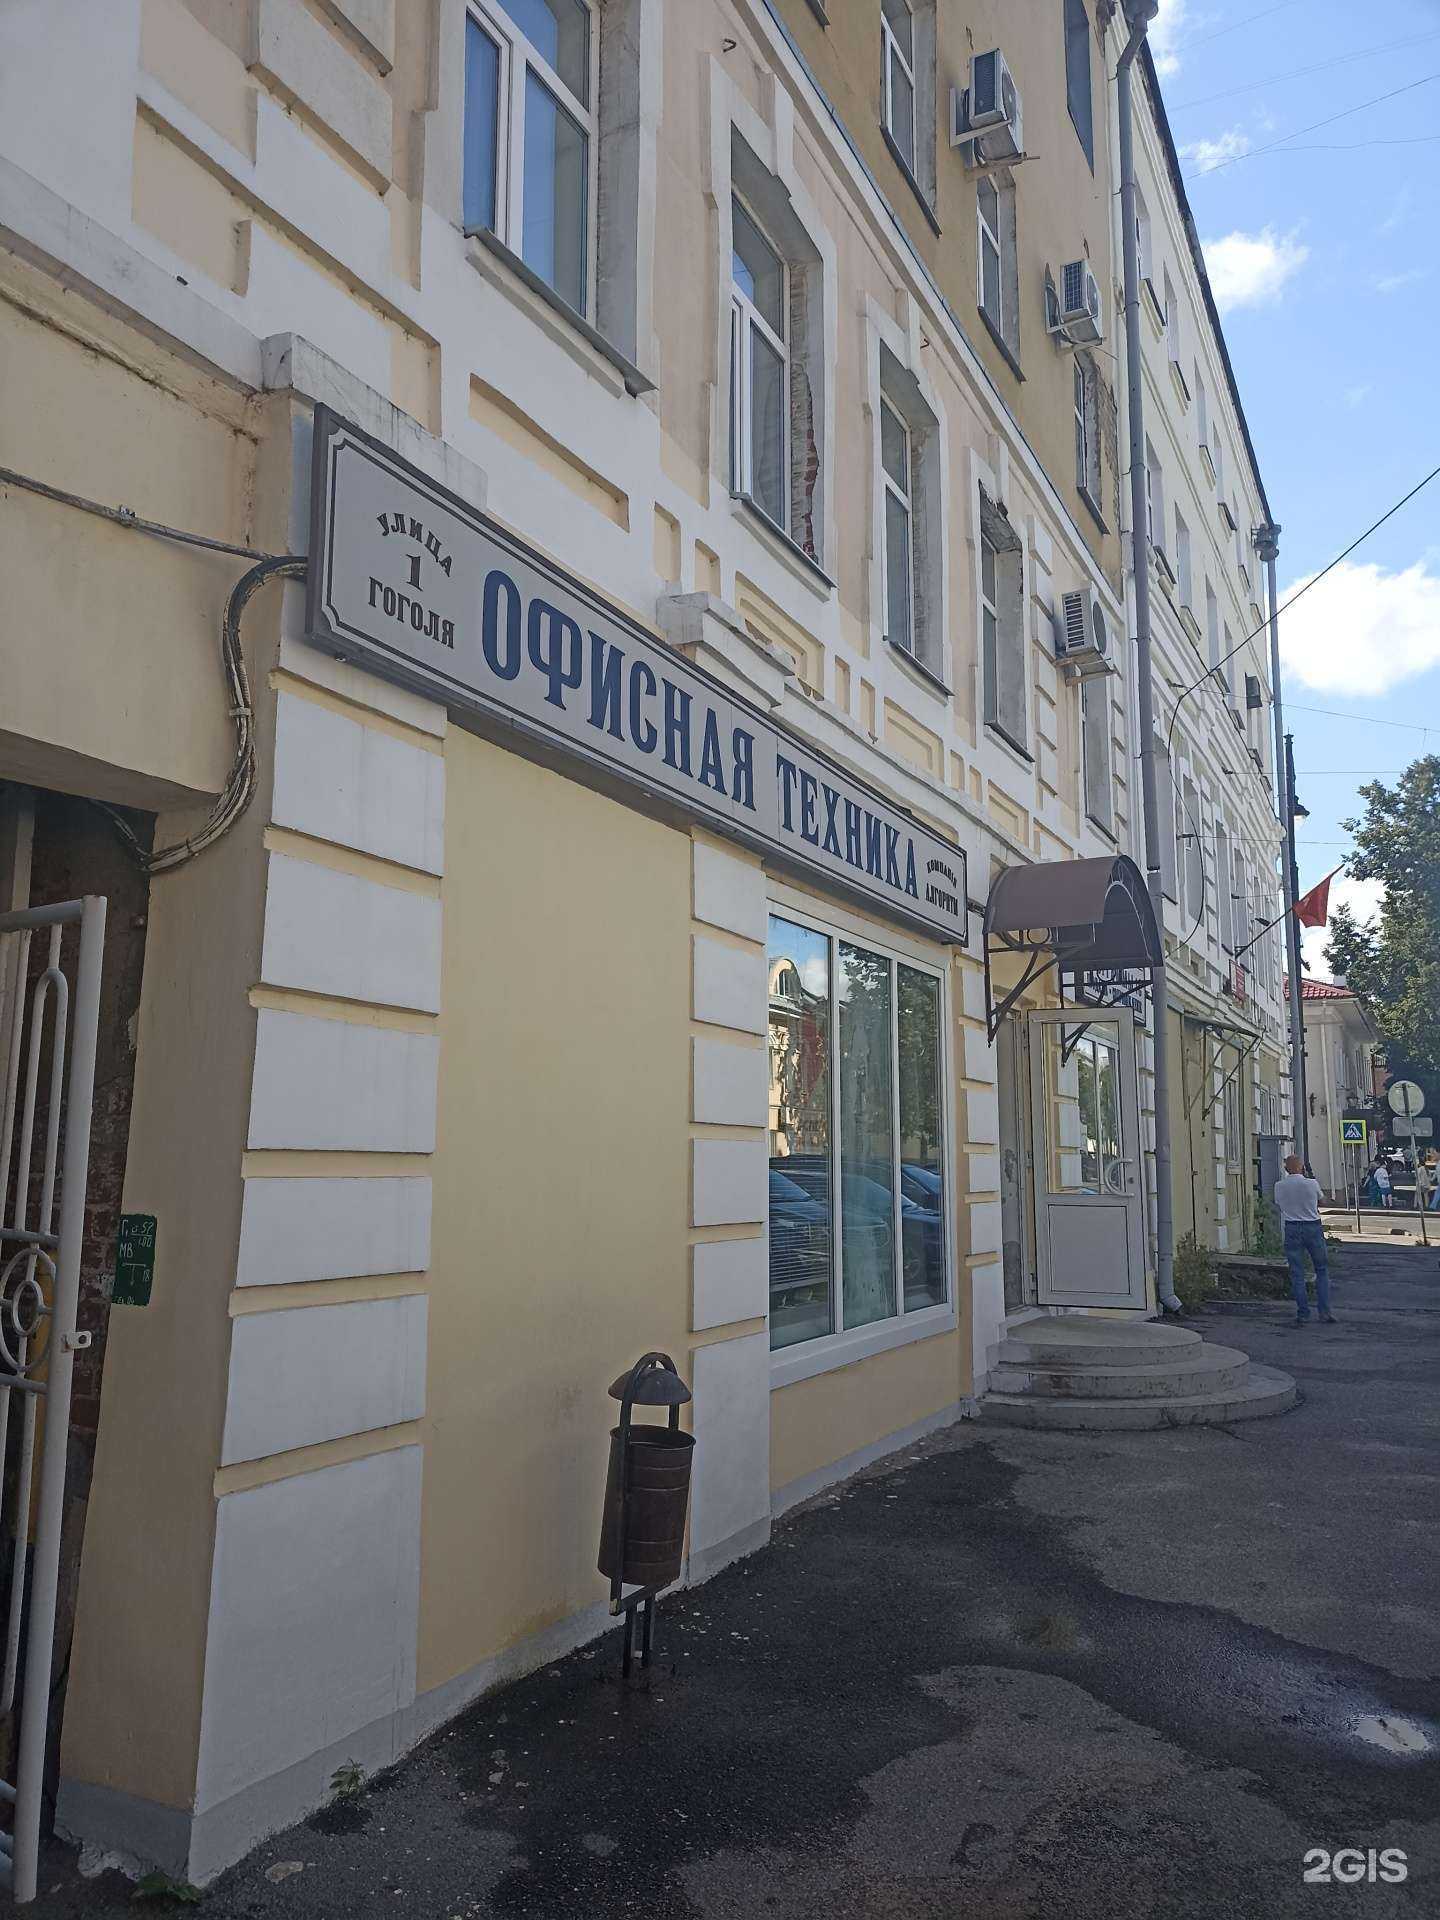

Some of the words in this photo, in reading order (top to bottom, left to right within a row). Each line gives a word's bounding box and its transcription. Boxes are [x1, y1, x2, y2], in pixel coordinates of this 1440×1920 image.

[376, 512, 453, 578] УЛИЦА
[405, 553, 423, 592] 1
[368, 576, 455, 649] ГОГОЛЯ
[482, 569, 757, 812] ОФИСНАЯ
[777, 753, 919, 900] ТЕХНИКА
